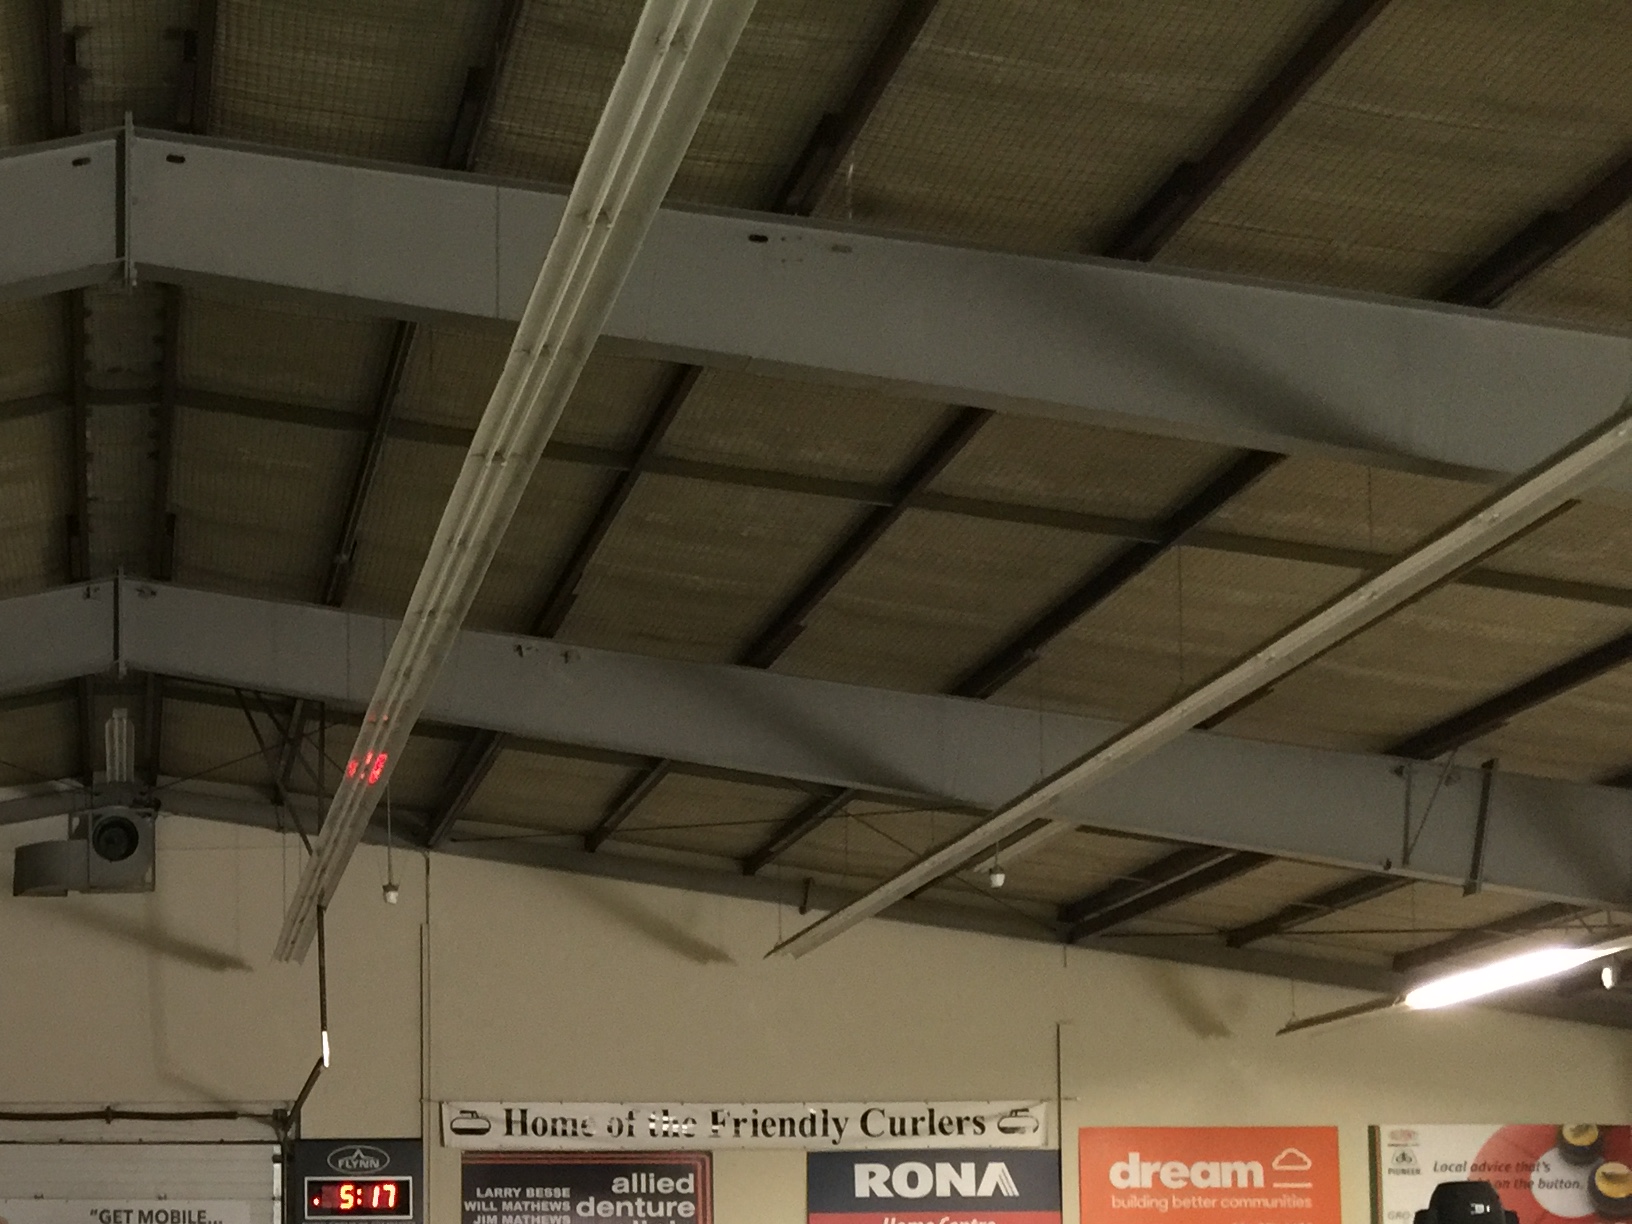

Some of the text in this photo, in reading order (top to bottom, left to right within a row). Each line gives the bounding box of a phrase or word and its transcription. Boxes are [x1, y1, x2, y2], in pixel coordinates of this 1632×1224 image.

[504, 1108, 986, 1145] Home of the Friendly Curlers
[337, 1157, 381, 1169] FLYNN
[1109, 1152, 1265, 1189] dream
[1433, 1161, 1551, 1173] Local advice that's
[611, 1172, 695, 1194] allied
[853, 1161, 1020, 1198] RONA
[1513, 1178, 1535, 1190] the
[1538, 1178, 1584, 1191] button.
[339, 1184, 396, 1210] 5:17
[476, 1187, 522, 1199] LARRY
[464, 1201, 571, 1212] WILL MATHEWS
[576, 1196, 696, 1218] denture
[1111, 1194, 1312, 1212] building better communities
[138, 1209, 223, 1224] MOBILE...
